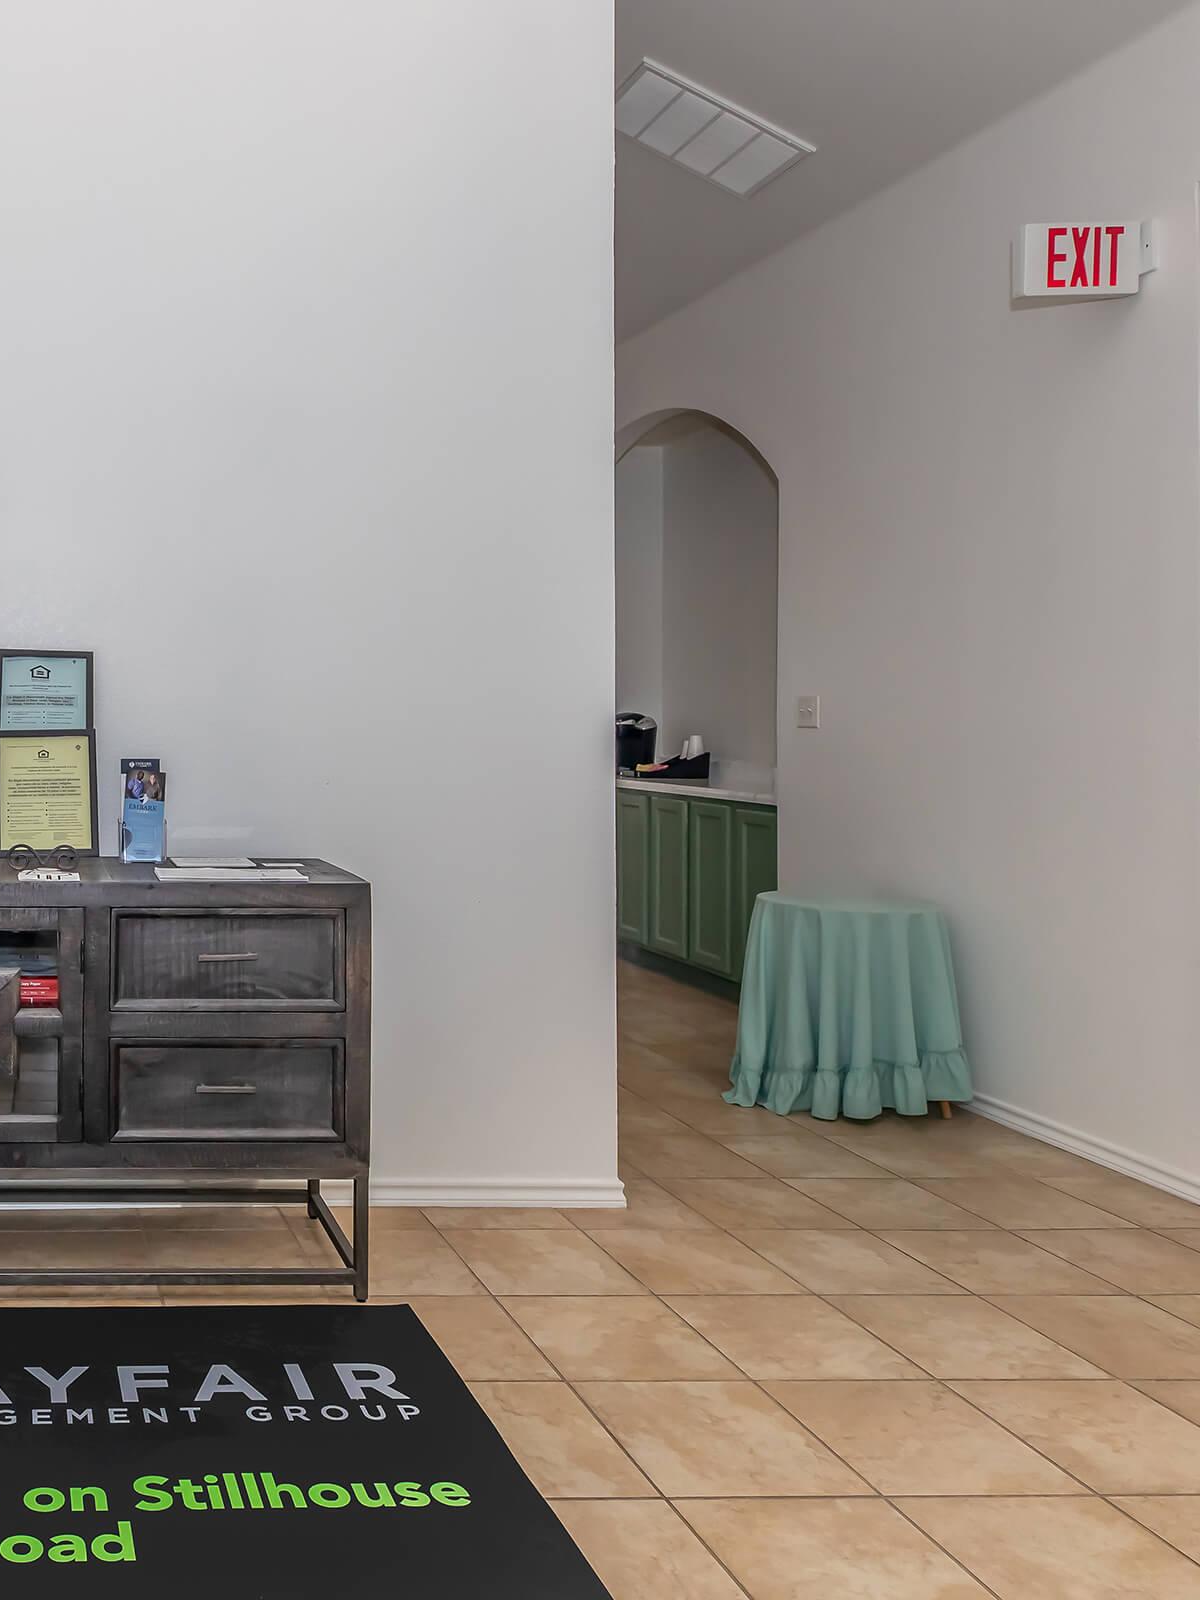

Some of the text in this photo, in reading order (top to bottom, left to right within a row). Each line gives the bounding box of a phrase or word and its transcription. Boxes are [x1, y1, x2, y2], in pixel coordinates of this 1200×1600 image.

[1047, 226, 1124, 288] EXIT
[246, 1404, 420, 1422] GROUP
[24, 1486, 109, 1515] on
[133, 1473, 470, 1511] Stillhouse
